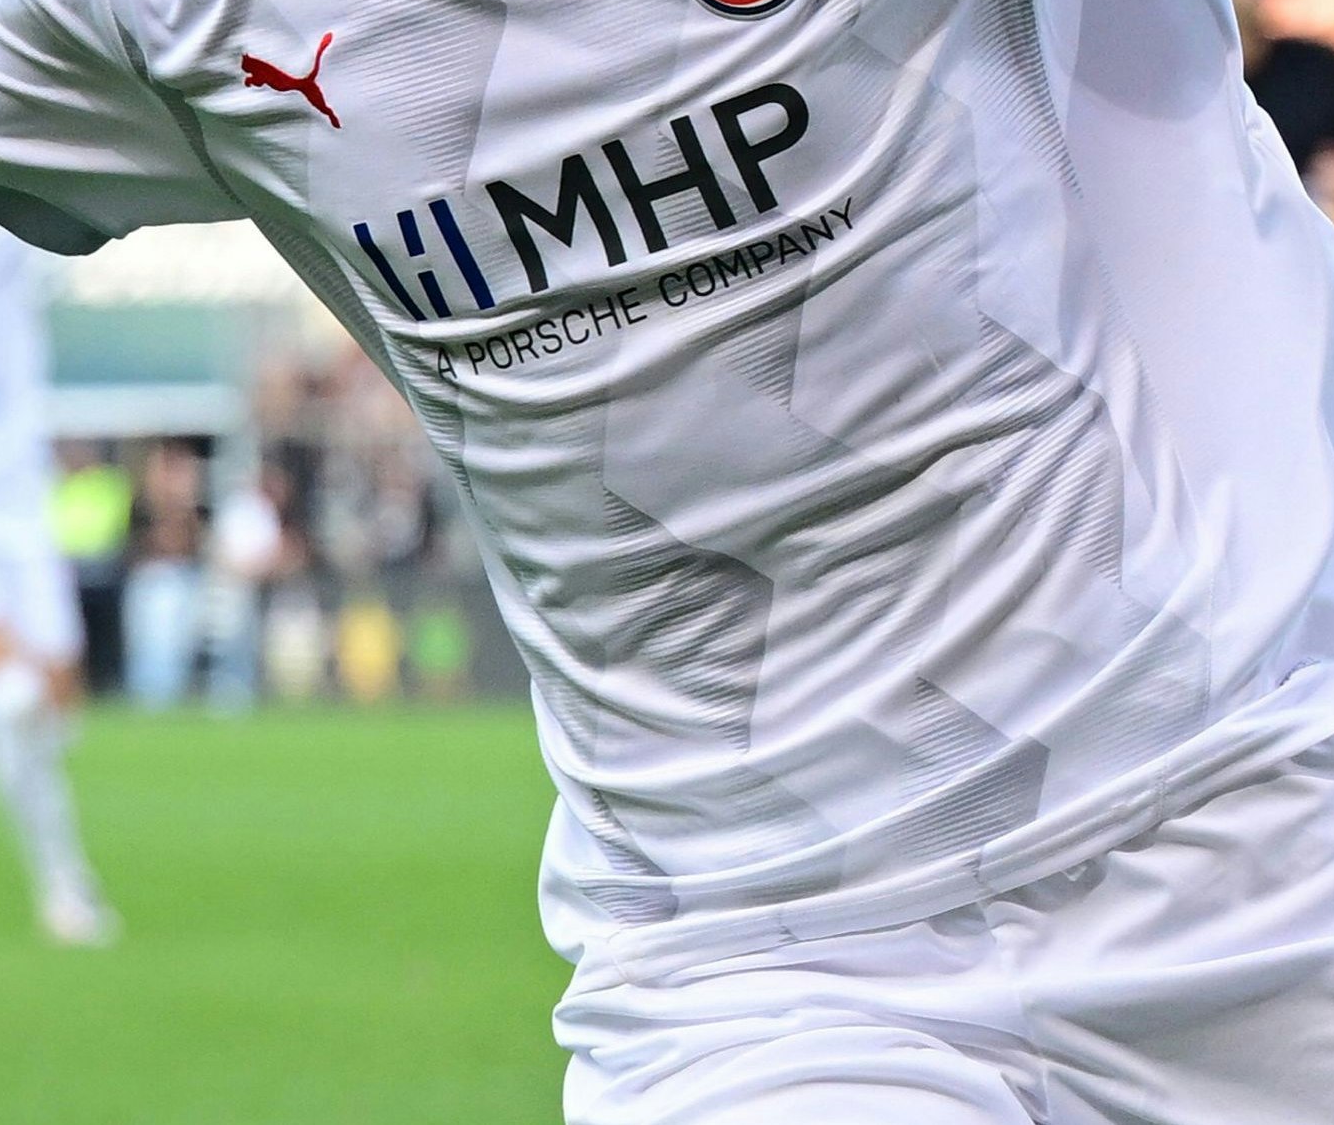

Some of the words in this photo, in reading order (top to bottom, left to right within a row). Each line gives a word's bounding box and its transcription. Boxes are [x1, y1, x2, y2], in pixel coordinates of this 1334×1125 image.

[485, 82, 810, 294] MHP
[436, 347, 458, 379] A
[468, 286, 648, 376] PORSCHE
[657, 196, 854, 309] COMPANY
